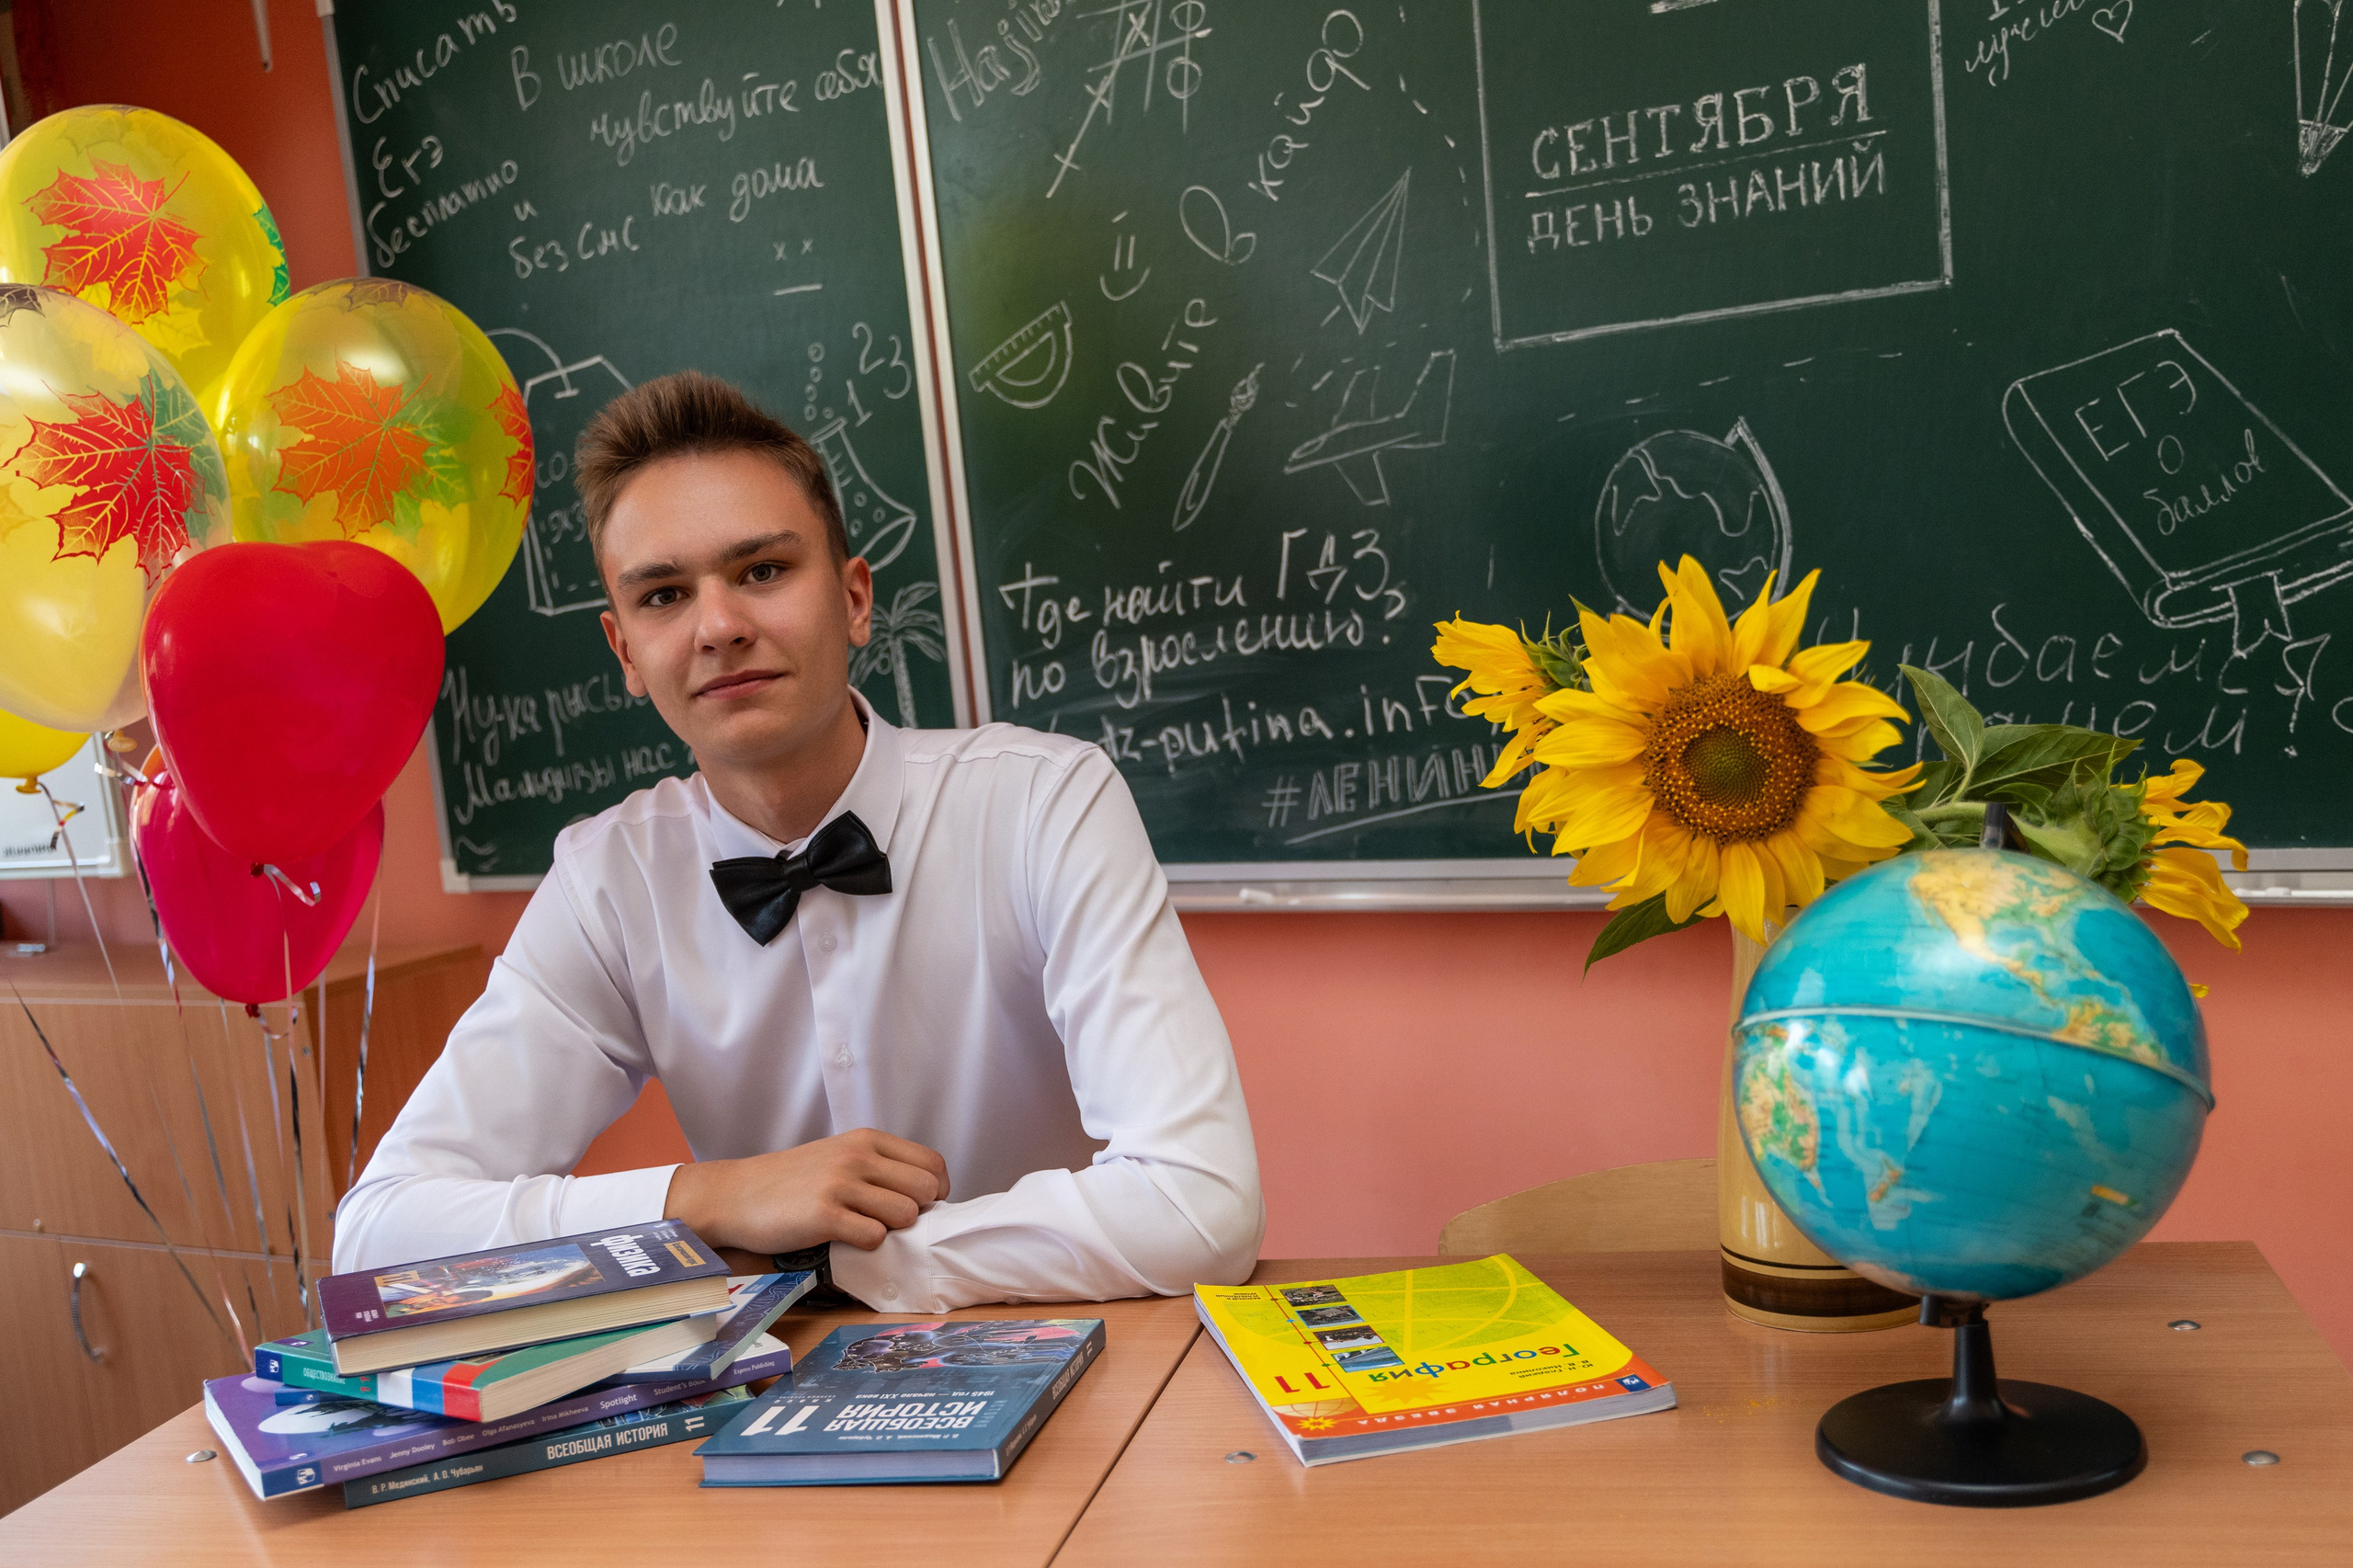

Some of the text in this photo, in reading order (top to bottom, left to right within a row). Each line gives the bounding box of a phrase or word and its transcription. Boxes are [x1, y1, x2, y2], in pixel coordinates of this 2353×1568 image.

[557, 22, 682, 90] школе
[590, 72, 800, 167] чувствуйте
[1532, 62, 1872, 179] СЕНТЯБРЯ
[729, 156, 825, 222] дома
[1527, 140, 1884, 255] ДЕНЬ ЗНАНИЙ
[368, 159, 518, 268] бесплатно
[509, 235, 569, 278] без
[2074, 361, 2197, 461] ЕГЭ
[2143, 428, 2267, 536] баллов
[1104, 562, 1247, 627] найти
[1278, 528, 1390, 607] ГДЗ
[1012, 659, 1066, 710] по
[733, 1360, 776, 1376] Express Publishing
[1274, 1372, 1331, 1393] 11
[1369, 1343, 1580, 1383] География
[1509, 1364, 1562, 1376] Николина
[1518, 1369, 1563, 1379] Гладкий
[334, 1459, 360, 1471] Virginia
[362, 1456, 382, 1466] Evans
[390, 1449, 411, 1460] Jenny
[412, 1442, 436, 1454] Dooley
[442, 1437, 456, 1447] Bob
[483, 1427, 497, 1437] Olga
[498, 1418, 535, 1434] Afanasyeva
[541, 1414, 558, 1423] Irina
[558, 1405, 589, 1419] Mikheeva
[599, 1393, 638, 1410] Spotlight
[654, 1381, 688, 1396] Student's
[740, 1404, 821, 1437] 11
[824, 1415, 975, 1433] ВСЕОБЩАЯ
[836, 1400, 987, 1419] ИСТОРИЯ
[1356, 1384, 1605, 1426] ПОЛЯРНАЯ ЗВЕЗДА
[547, 1415, 705, 1460] ВСЕОБЩАЯ ИСТОРИЯ 11
[371, 1484, 380, 1494] В.
[434, 1471, 442, 1482] А.
[450, 1464, 483, 1478] Чубарьян
